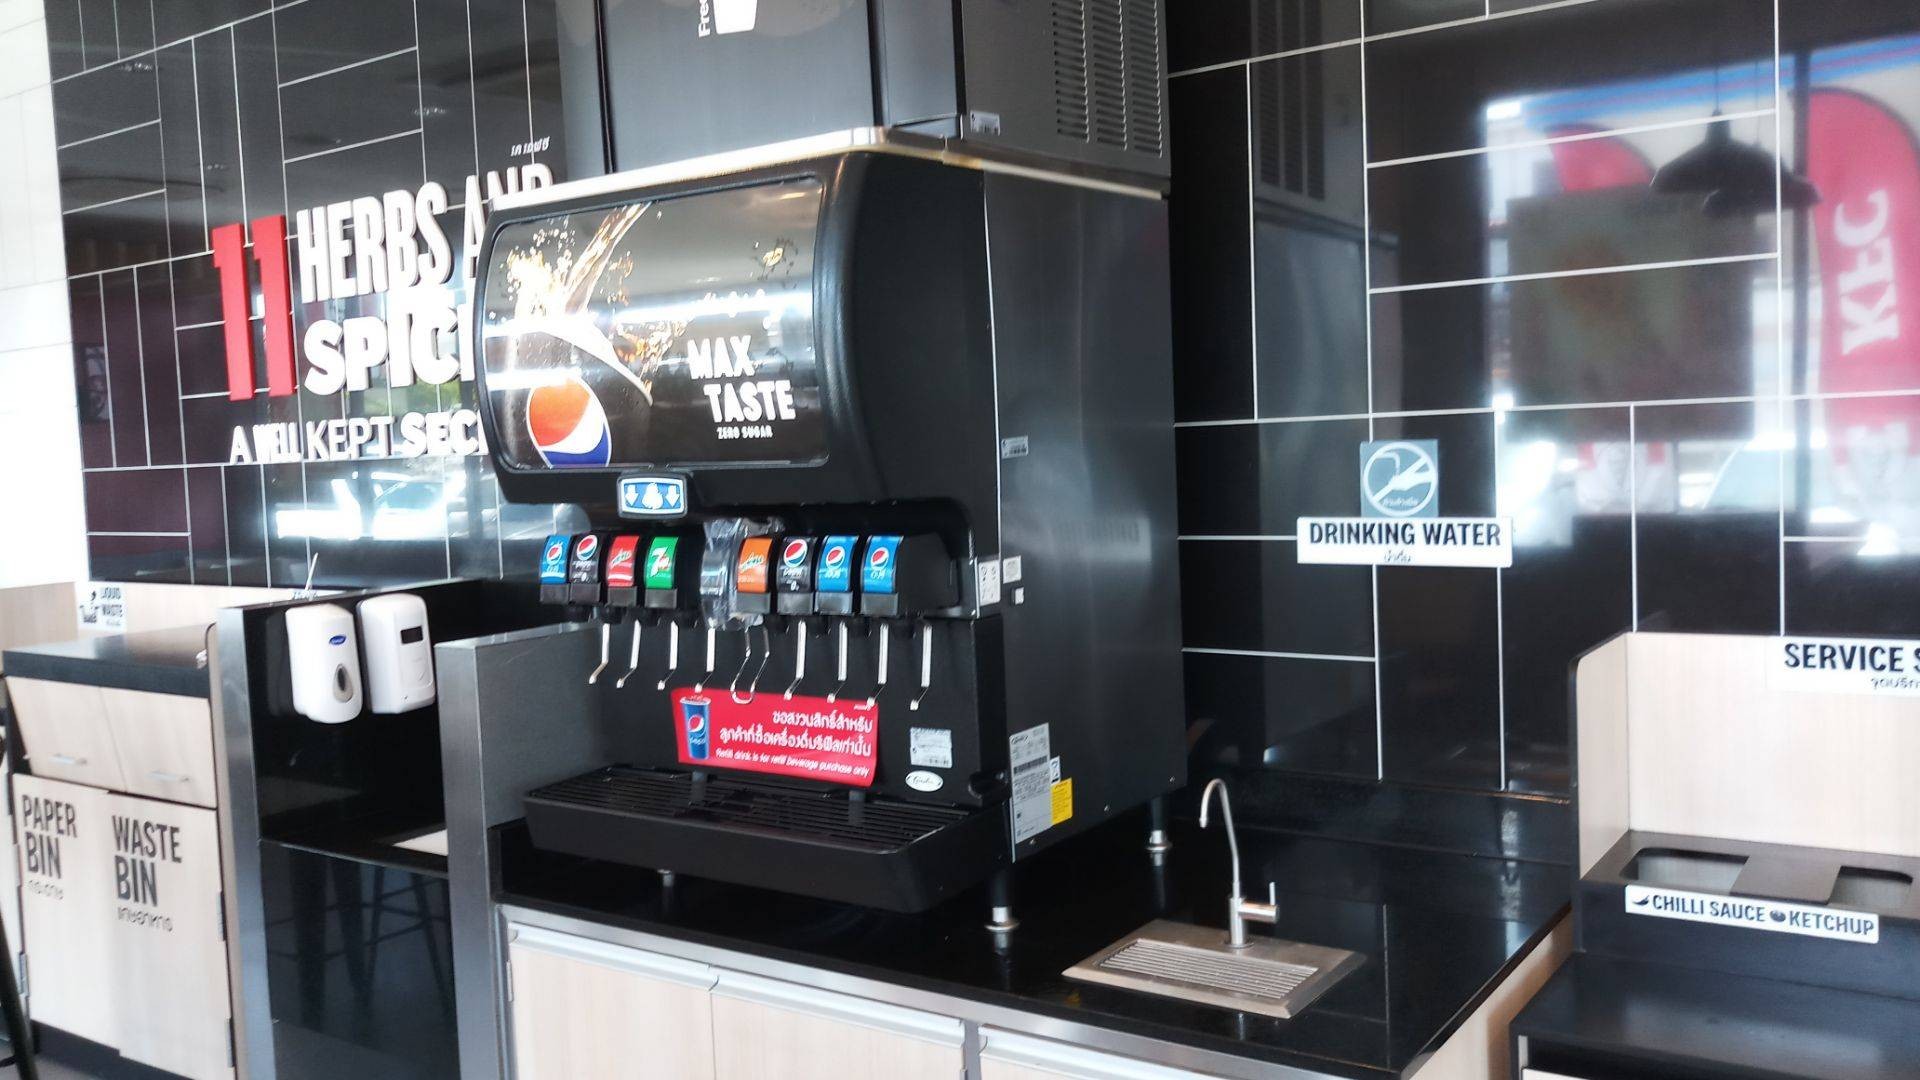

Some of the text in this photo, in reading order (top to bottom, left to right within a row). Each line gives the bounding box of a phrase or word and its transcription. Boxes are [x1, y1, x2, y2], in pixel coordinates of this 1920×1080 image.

[296, 181, 455, 304] HERBS
[212, 214, 297, 402] 11
[687, 335, 755, 380] MAX
[703, 379, 796, 423] TASTE
[229, 425, 253, 464] A
[252, 421, 303, 464] WELL
[306, 415, 395, 461] KEPT
[716, 425, 773, 439] ZERO SUGAR
[1309, 521, 1501, 547] DRINKING WATER
[1784, 642, 1904, 673] SERVICE
[734, 750, 751, 761] drink
[751, 751, 758, 762] is
[759, 752, 769, 763] for
[770, 754, 787, 765] refill
[787, 755, 818, 770] beverage
[819, 760, 852, 774] purchase
[852, 766, 870, 779] only
[22, 794, 77, 838] PAPER
[25, 831, 62, 879] BIN
[112, 815, 182, 863] WASTE
[114, 855, 158, 907] BIN
[1652, 894, 1875, 936] CHILLI SAUCE KETCHUP
